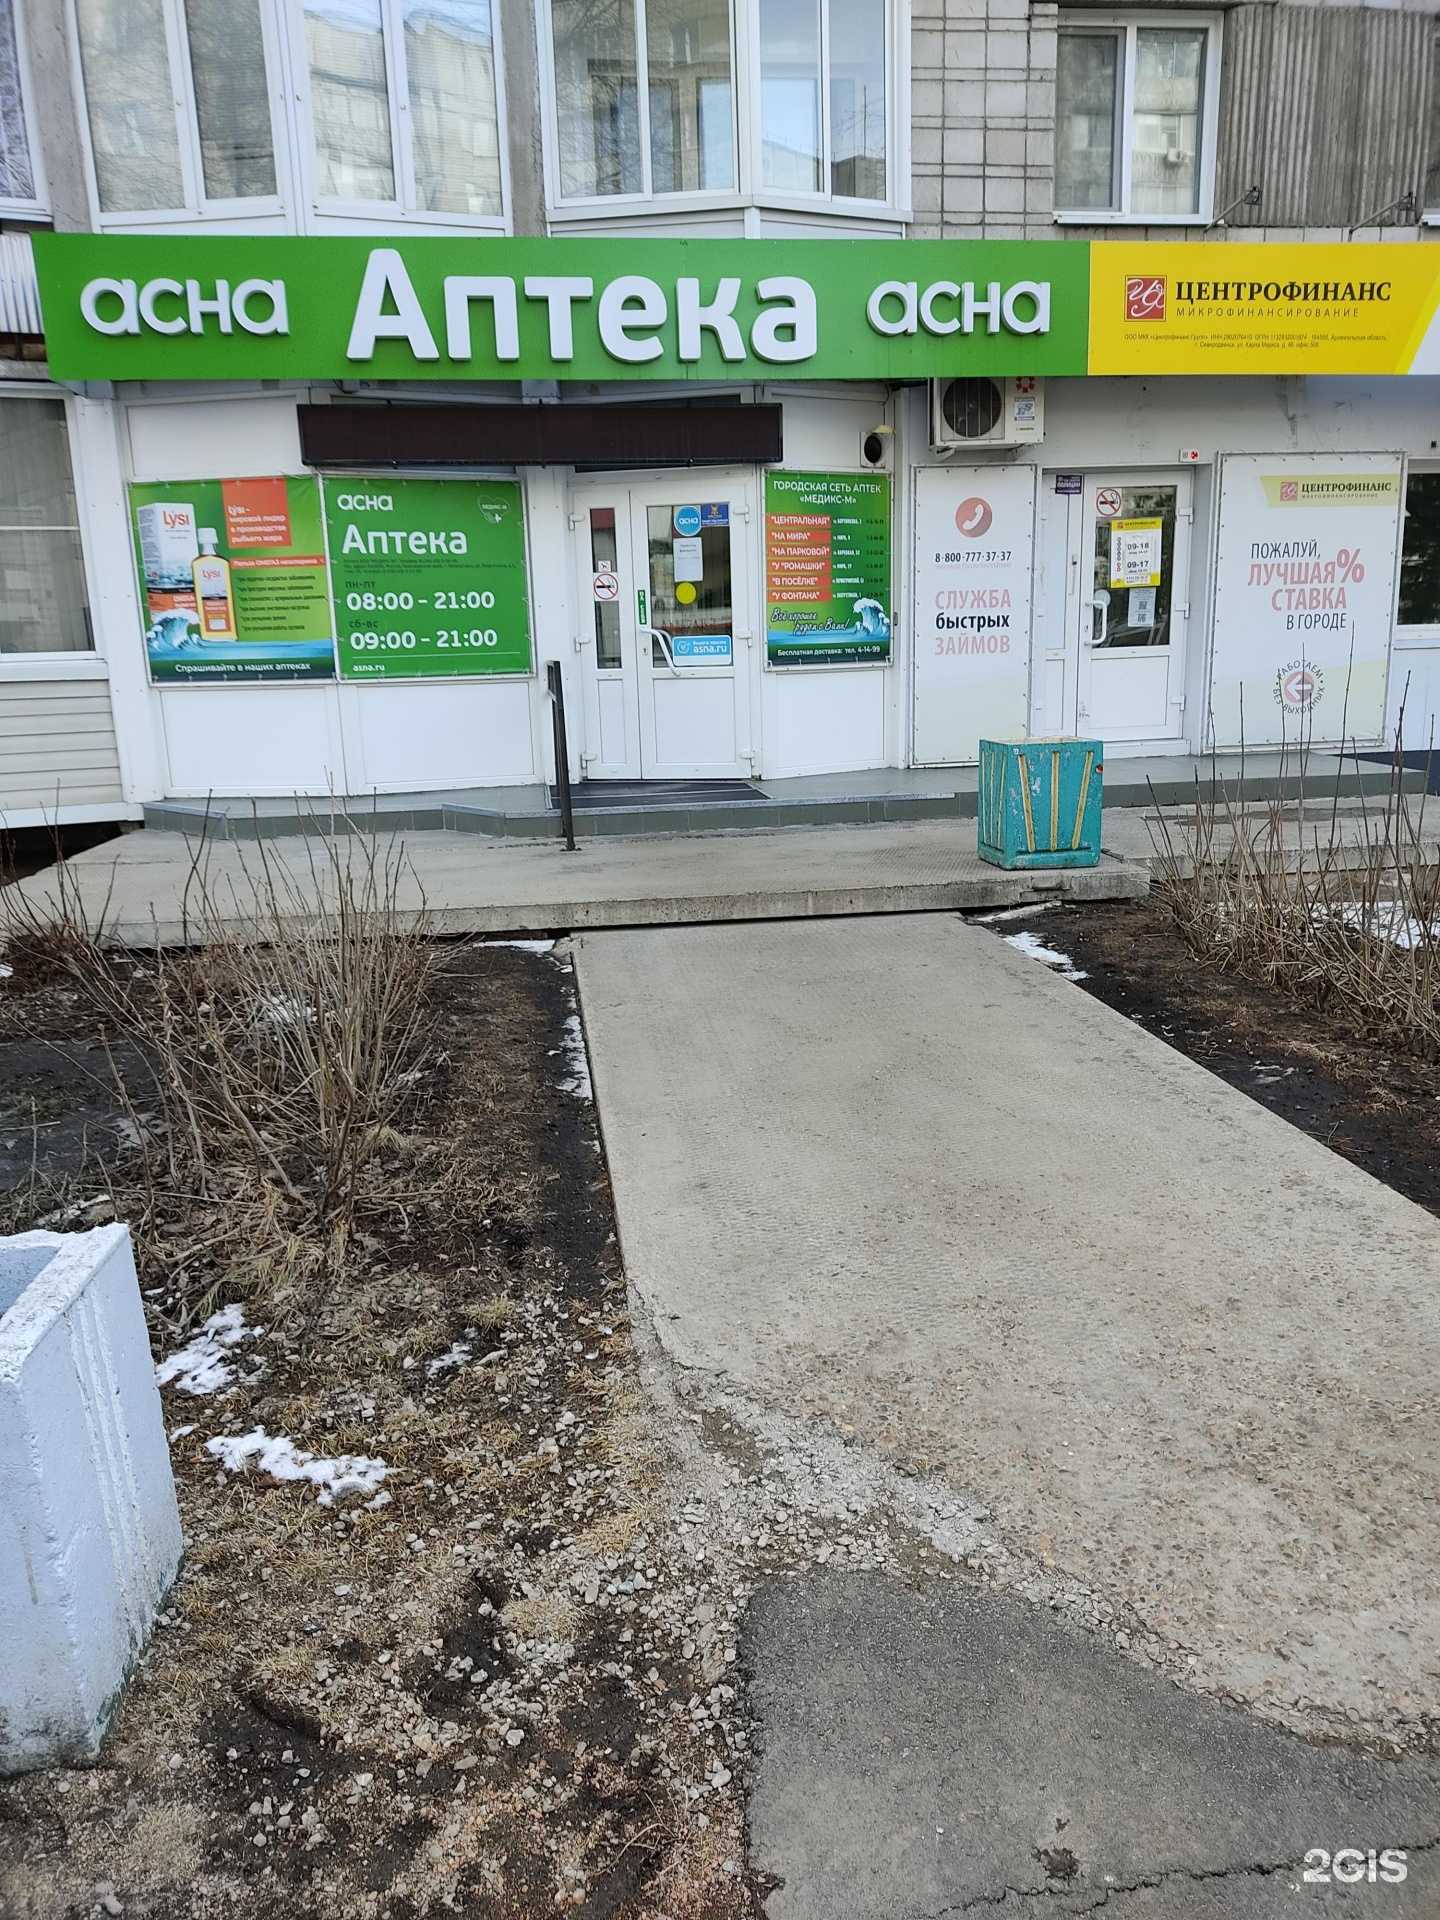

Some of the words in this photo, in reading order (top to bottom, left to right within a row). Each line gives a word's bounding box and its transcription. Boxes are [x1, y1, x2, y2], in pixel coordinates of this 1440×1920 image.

[1175, 280, 1392, 304] ЦЕНТРОФИНАНС
[80, 277, 289, 336] асна
[346, 248, 817, 364] Аптека
[867, 280, 1051, 336] асна
[1176, 307, 1360, 319] МИКРОФИНАНСИРОВАНИЕ
[773, 480, 828, 492] ГОРОДСКАЯ
[829, 482, 851, 492] СЕТЬ
[852, 484, 881, 493] АПТЕК
[1302, 482, 1391, 493] ЦЕНТРОФИНАНС
[337, 494, 393, 511] асна
[800, 494, 857, 504] «МЕДИКС-М»
[342, 524, 468, 555] Аптека
[1251, 539, 1321, 559] ПОЖАЛУЙ,
[1127, 560, 1149, 568] 09-17
[1248, 561, 1336, 586] ЛУЧШАЯ
[346, 591, 414, 611] 08:00
[434, 591, 496, 609] 21:00
[934, 589, 1012, 609] СЛУЖБА
[1271, 587, 1347, 611] СТАВКА
[935, 612, 1010, 632] быстрых
[1286, 614, 1294, 630] В
[1297, 613, 1347, 631] ГОРОДЕ
[350, 631, 416, 650] 09:00
[436, 629, 498, 648] 21:00
[934, 633, 1010, 656] ЗАЙМОВ
[814, 648, 843, 656] доставка:
[175, 663, 236, 673] Спрашивайте
[237, 664, 244, 672] в
[244, 664, 274, 672] наших
[275, 662, 311, 671] аптеках
[352, 664, 385, 672] asna.ru
